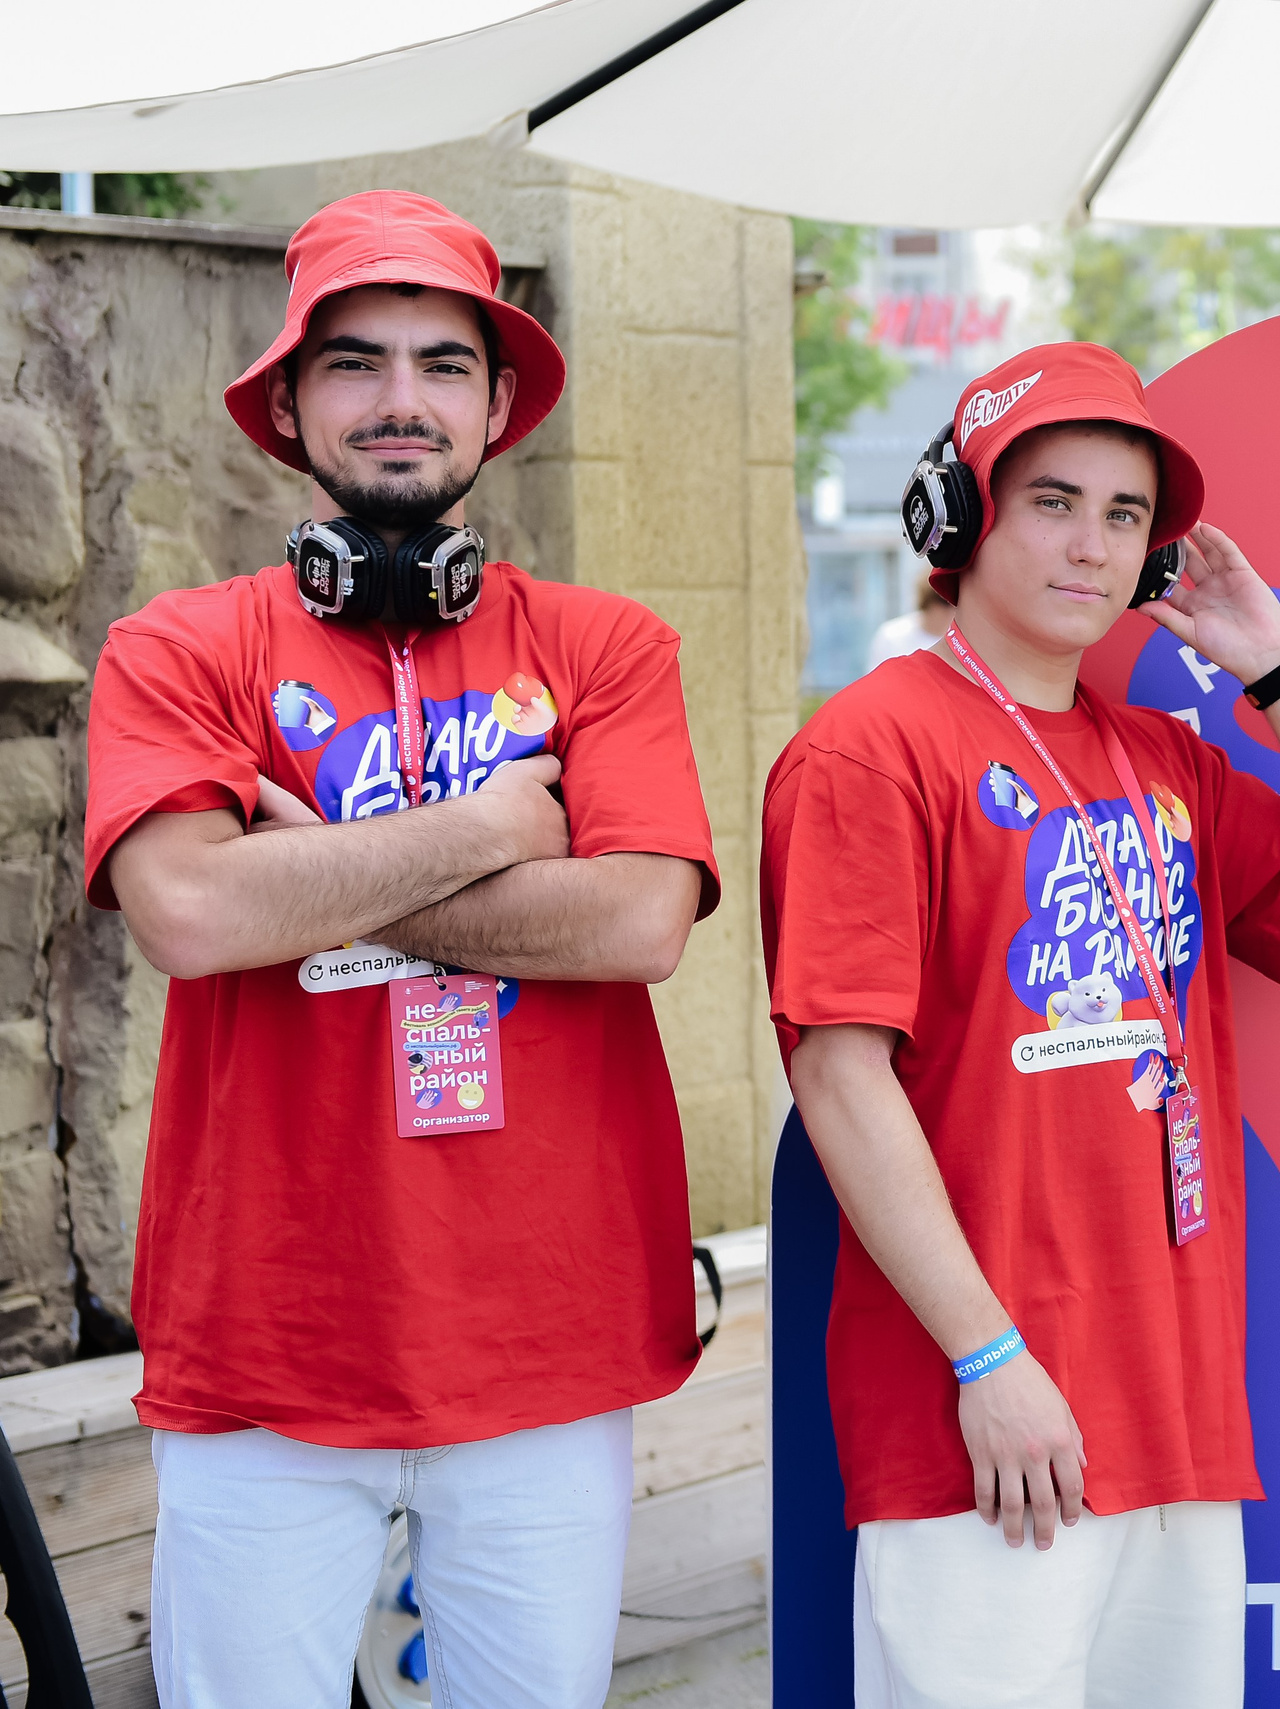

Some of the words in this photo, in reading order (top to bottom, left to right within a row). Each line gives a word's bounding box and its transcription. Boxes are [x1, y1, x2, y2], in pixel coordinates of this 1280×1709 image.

[962, 394, 986, 444] НЕ
[983, 381, 1031, 423] СПАТЬ
[951, 636, 968, 657] район
[397, 673, 410, 704] район
[964, 654, 1006, 702] неспальный
[399, 705, 413, 770] неспальный
[1015, 714, 1037, 742] район
[341, 710, 508, 823] ДАЮ
[1127, 920, 1145, 953] район
[1026, 940, 1073, 986] НА
[1138, 952, 1167, 1015] неспальный
[406, 1024, 491, 1043] спаль-
[1039, 1029, 1167, 1057] неспальныйрайон.р
[434, 1042, 486, 1066] ный
[409, 1067, 488, 1096] район
[413, 1113, 490, 1129] Организатор
[1178, 1177, 1203, 1207] район
[954, 1329, 1023, 1378] еспальный
